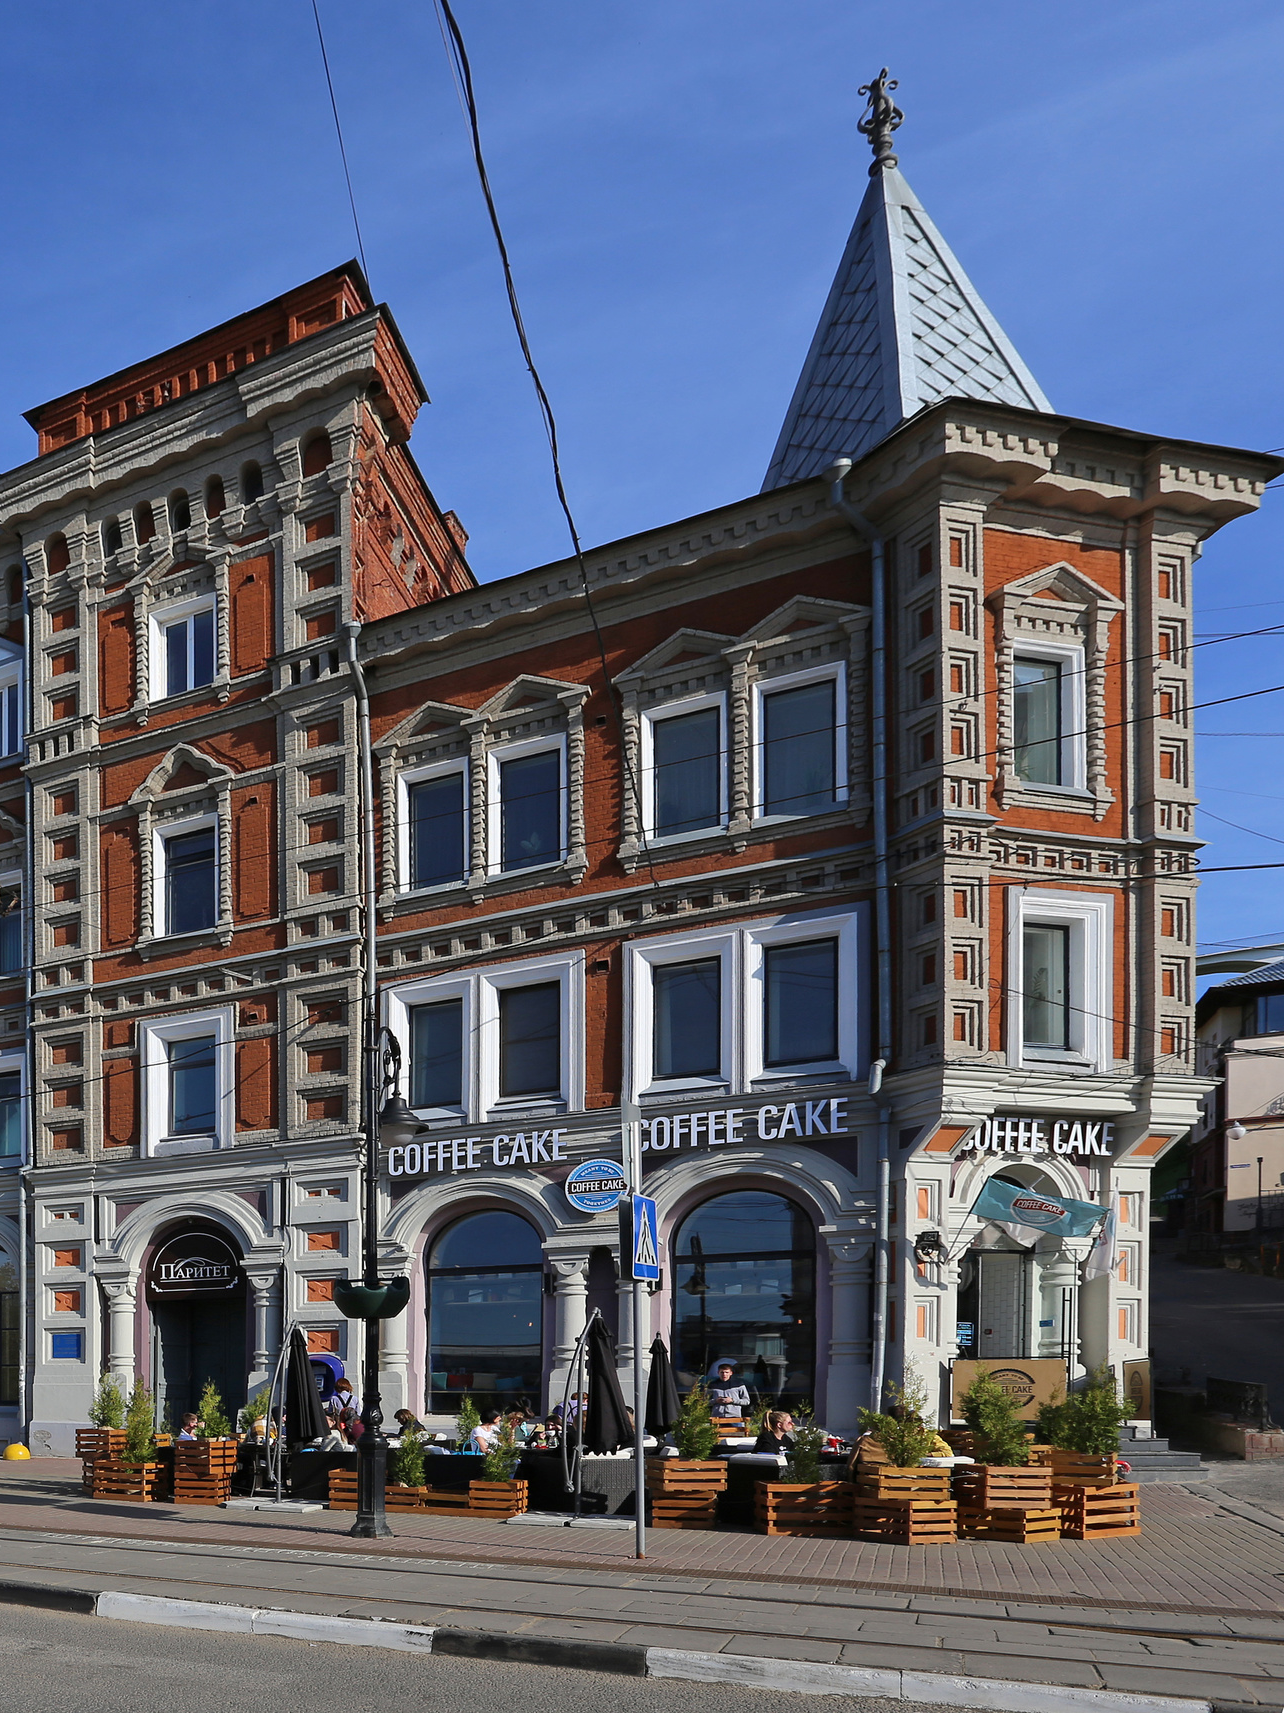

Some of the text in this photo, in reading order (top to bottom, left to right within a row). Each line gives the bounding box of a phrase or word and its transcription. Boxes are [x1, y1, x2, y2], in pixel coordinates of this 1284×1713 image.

[757, 1097, 849, 1140] CAKE
[1053, 1119, 1116, 1156] CAKE
[388, 1128, 568, 1176] COFFEE CAKE
[571, 1179, 624, 1193] COFFEE CAKE
[1016, 1200, 1062, 1214] COFFEE CAKE
[1012, 1385, 1033, 1394] CAKE
